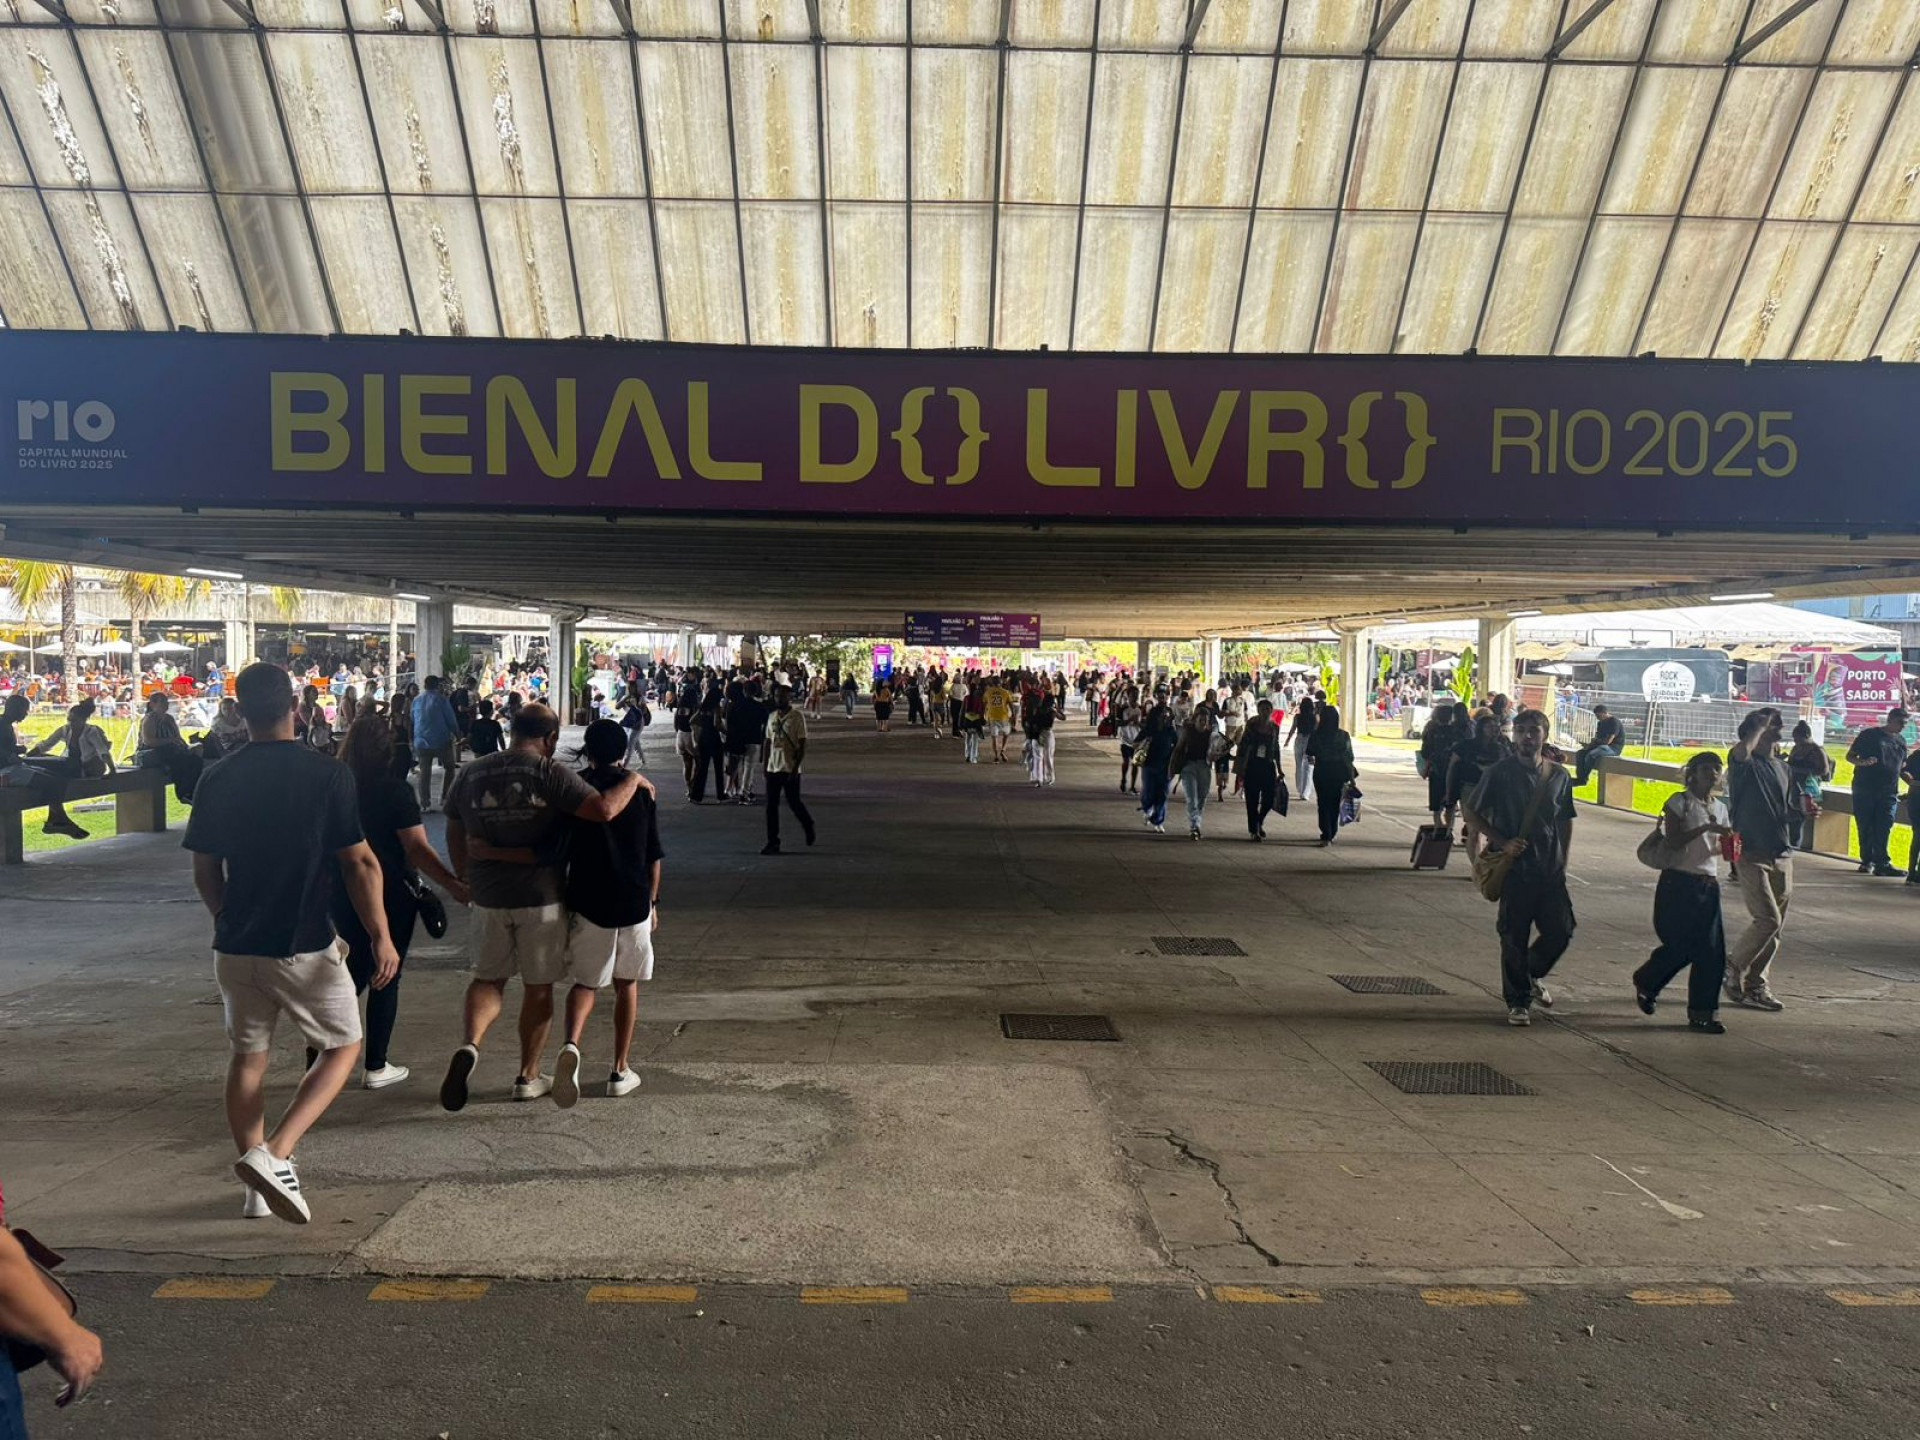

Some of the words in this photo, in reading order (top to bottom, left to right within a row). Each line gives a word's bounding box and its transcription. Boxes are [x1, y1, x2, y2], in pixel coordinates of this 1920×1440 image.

[269, 371, 763, 482] BIENAL
[1491, 407, 1611, 475] RIO
[1625, 409, 1798, 478] 2025
[18, 448, 69, 457] CAPITAL
[71, 449, 128, 458] MUNDIAL
[18, 459, 37, 468] DO
[40, 459, 78, 469] LIVRO
[80, 460, 113, 469] 2025
[1660, 671, 1678, 680] ROCK
[1847, 670, 1886, 681] PORTO
[1846, 690, 1886, 701] SABOR
